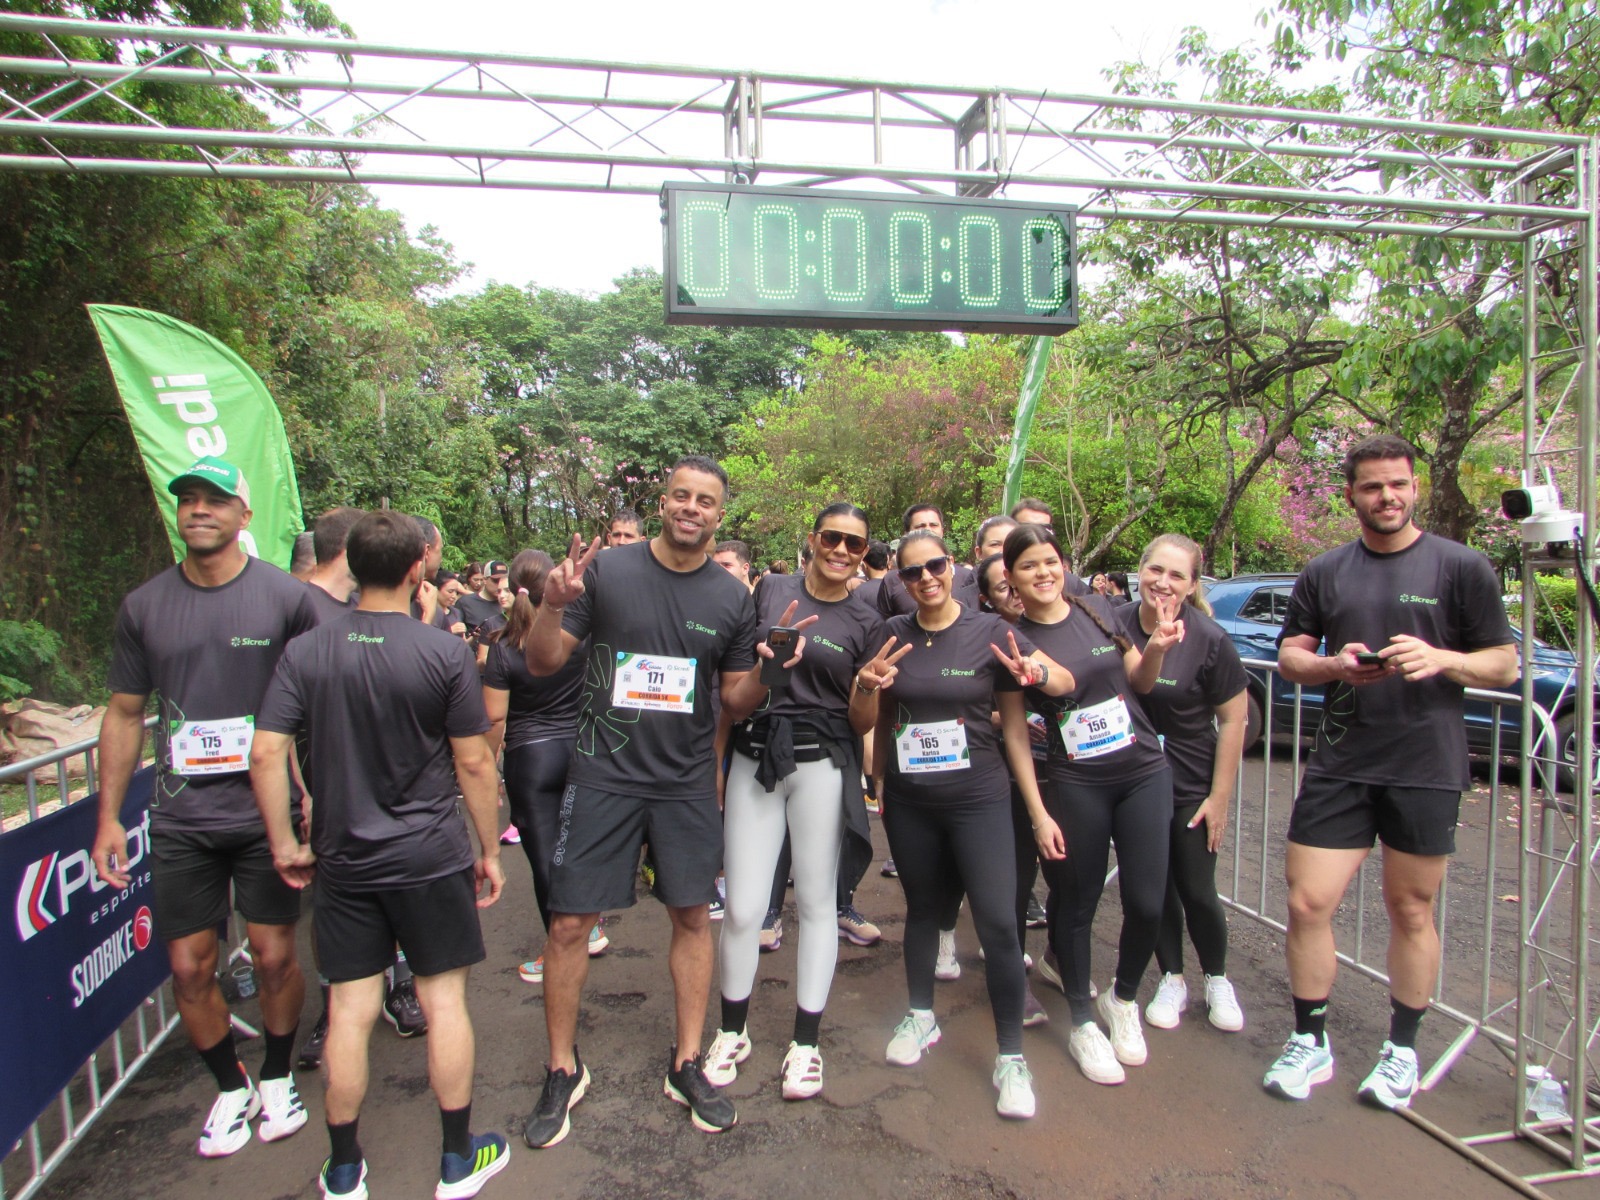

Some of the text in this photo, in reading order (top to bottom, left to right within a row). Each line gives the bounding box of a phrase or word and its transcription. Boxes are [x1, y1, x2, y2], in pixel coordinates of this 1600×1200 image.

[682, 200, 1063, 310] 00:00:00
[1410, 595, 1438, 605] Sicredi
[694, 623, 717, 636] Sicredi
[241, 637, 271, 646] Sicredi
[357, 634, 385, 644] Sicredi
[821, 638, 844, 653] Sicredi
[647, 671, 664, 685] 171
[950, 668, 976, 677] Sicredi
[647, 685, 662, 693] Caio
[1087, 717, 1108, 733] 156
[1089, 729, 1111, 741] Amanda
[201, 735, 222, 749] 175
[919, 737, 939, 749] 165
[71, 918, 136, 1009] SODBIKE
